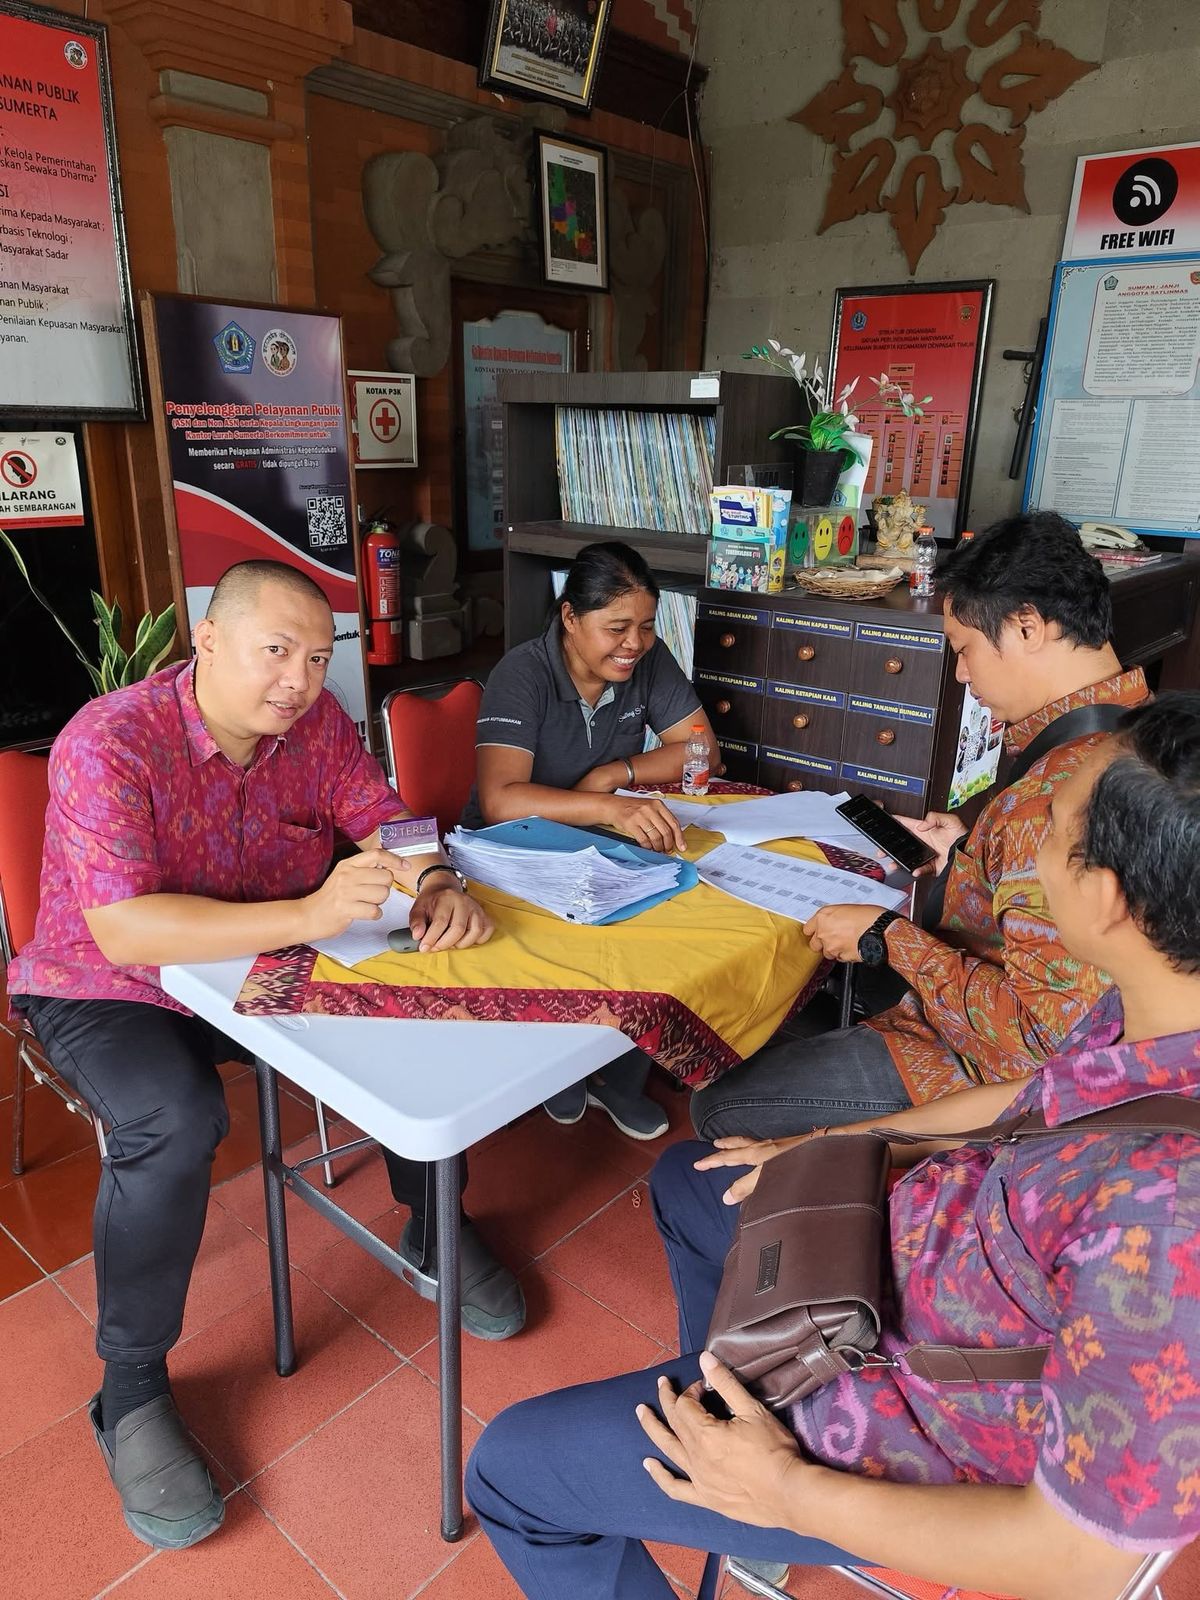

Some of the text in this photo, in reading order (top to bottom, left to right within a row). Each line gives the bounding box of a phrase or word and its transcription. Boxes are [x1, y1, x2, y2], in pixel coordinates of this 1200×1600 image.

[37, 82, 80, 104] PUBLIK
[4, 146, 96, 172] Kelola Pemerintahan
[25, 162, 58, 176] Sewaka
[20, 209, 52, 222] Kepada
[54, 214, 101, 230] Masyarakat
[27, 228, 69, 245] Teknologi
[1100, 228, 1175, 250] FREE WIFI
[46, 248, 69, 260] Sadar
[22, 281, 70, 296] Masyarakat
[18, 298, 44, 310] Publik
[38, 318, 78, 330] Kepuasan
[80, 322, 124, 334] Masyarakat
[366, 387, 388, 395] KOTAK
[166, 402, 341, 418] Penyelenggara Pelayanan Publik
[192, 418, 208, 427] dan
[208, 418, 223, 427] Non
[224, 418, 240, 427] ASN
[185, 431, 212, 440] Kantor
[234, 431, 264, 440] Sumerta
[188, 448, 228, 456] Memberikan
[228, 447, 260, 457] Pelayanan
[213, 462, 234, 470] secara
[262, 460, 278, 468] tidak
[14, 502, 76, 512] SEMBARANGAN
[776, 616, 794, 624] KALING
[861, 629, 882, 637] KALING
[900, 634, 920, 642] KAPAS
[920, 636, 940, 644] KELOD
[718, 676, 742, 686] KETAPIAN
[774, 687, 794, 695] KALING
[796, 690, 822, 700] KETAPIAN
[852, 700, 872, 709] KALING
[873, 703, 898, 713] TANJUNG
[724, 742, 748, 752] LINMAS
[857, 770, 878, 780] KALING
[399, 824, 434, 836] TEREA
